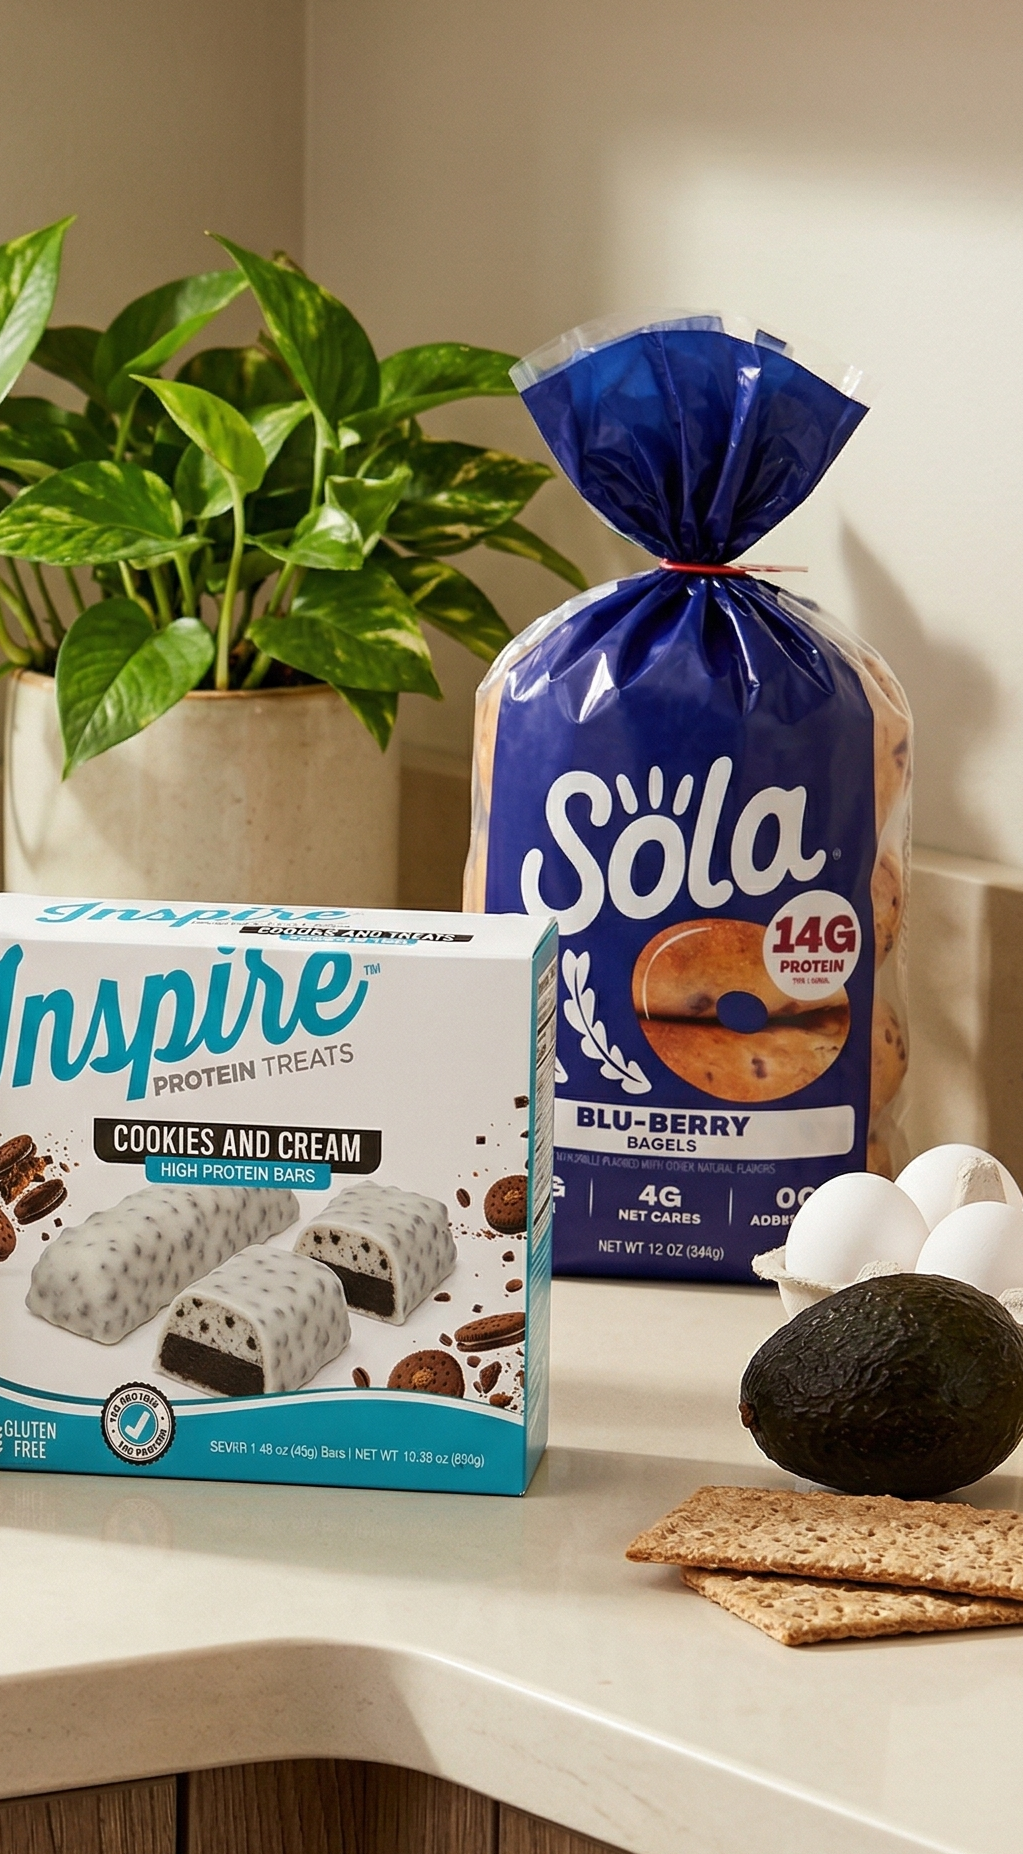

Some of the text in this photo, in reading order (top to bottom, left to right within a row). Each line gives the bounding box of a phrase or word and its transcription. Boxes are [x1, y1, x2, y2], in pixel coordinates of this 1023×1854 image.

[520, 756, 827, 936] Sola
[35, 901, 351, 927] Inspire
[772, 914, 856, 954] 14G
[780, 959, 844, 973] PROTEIN
[153, 1043, 354, 1097] PROTEIN TREATS
[577, 1106, 750, 1137] BLU-BERRY
[113, 1124, 361, 1163] COOKIES AND CREAM
[628, 1136, 697, 1153] BAGELS
[161, 1162, 316, 1183] HIGH PROTEIN BARS
[639, 1185, 682, 1207] 4G
[618, 1208, 701, 1224] NET CARES
[598, 1240, 622, 1253] NET
[625, 1241, 644, 1254] WT
[648, 1243, 663, 1256] 12
[666, 1243, 684, 1257] OZ
[4, 1419, 57, 1439] GLUTEN
[14, 1441, 46, 1458] FREE
[275, 1446, 288, 1456] oz
[290, 1444, 318, 1459] (45g)
[355, 1448, 377, 1460] NET
[380, 1449, 399, 1461] WT
[435, 1454, 449, 1464] oz
